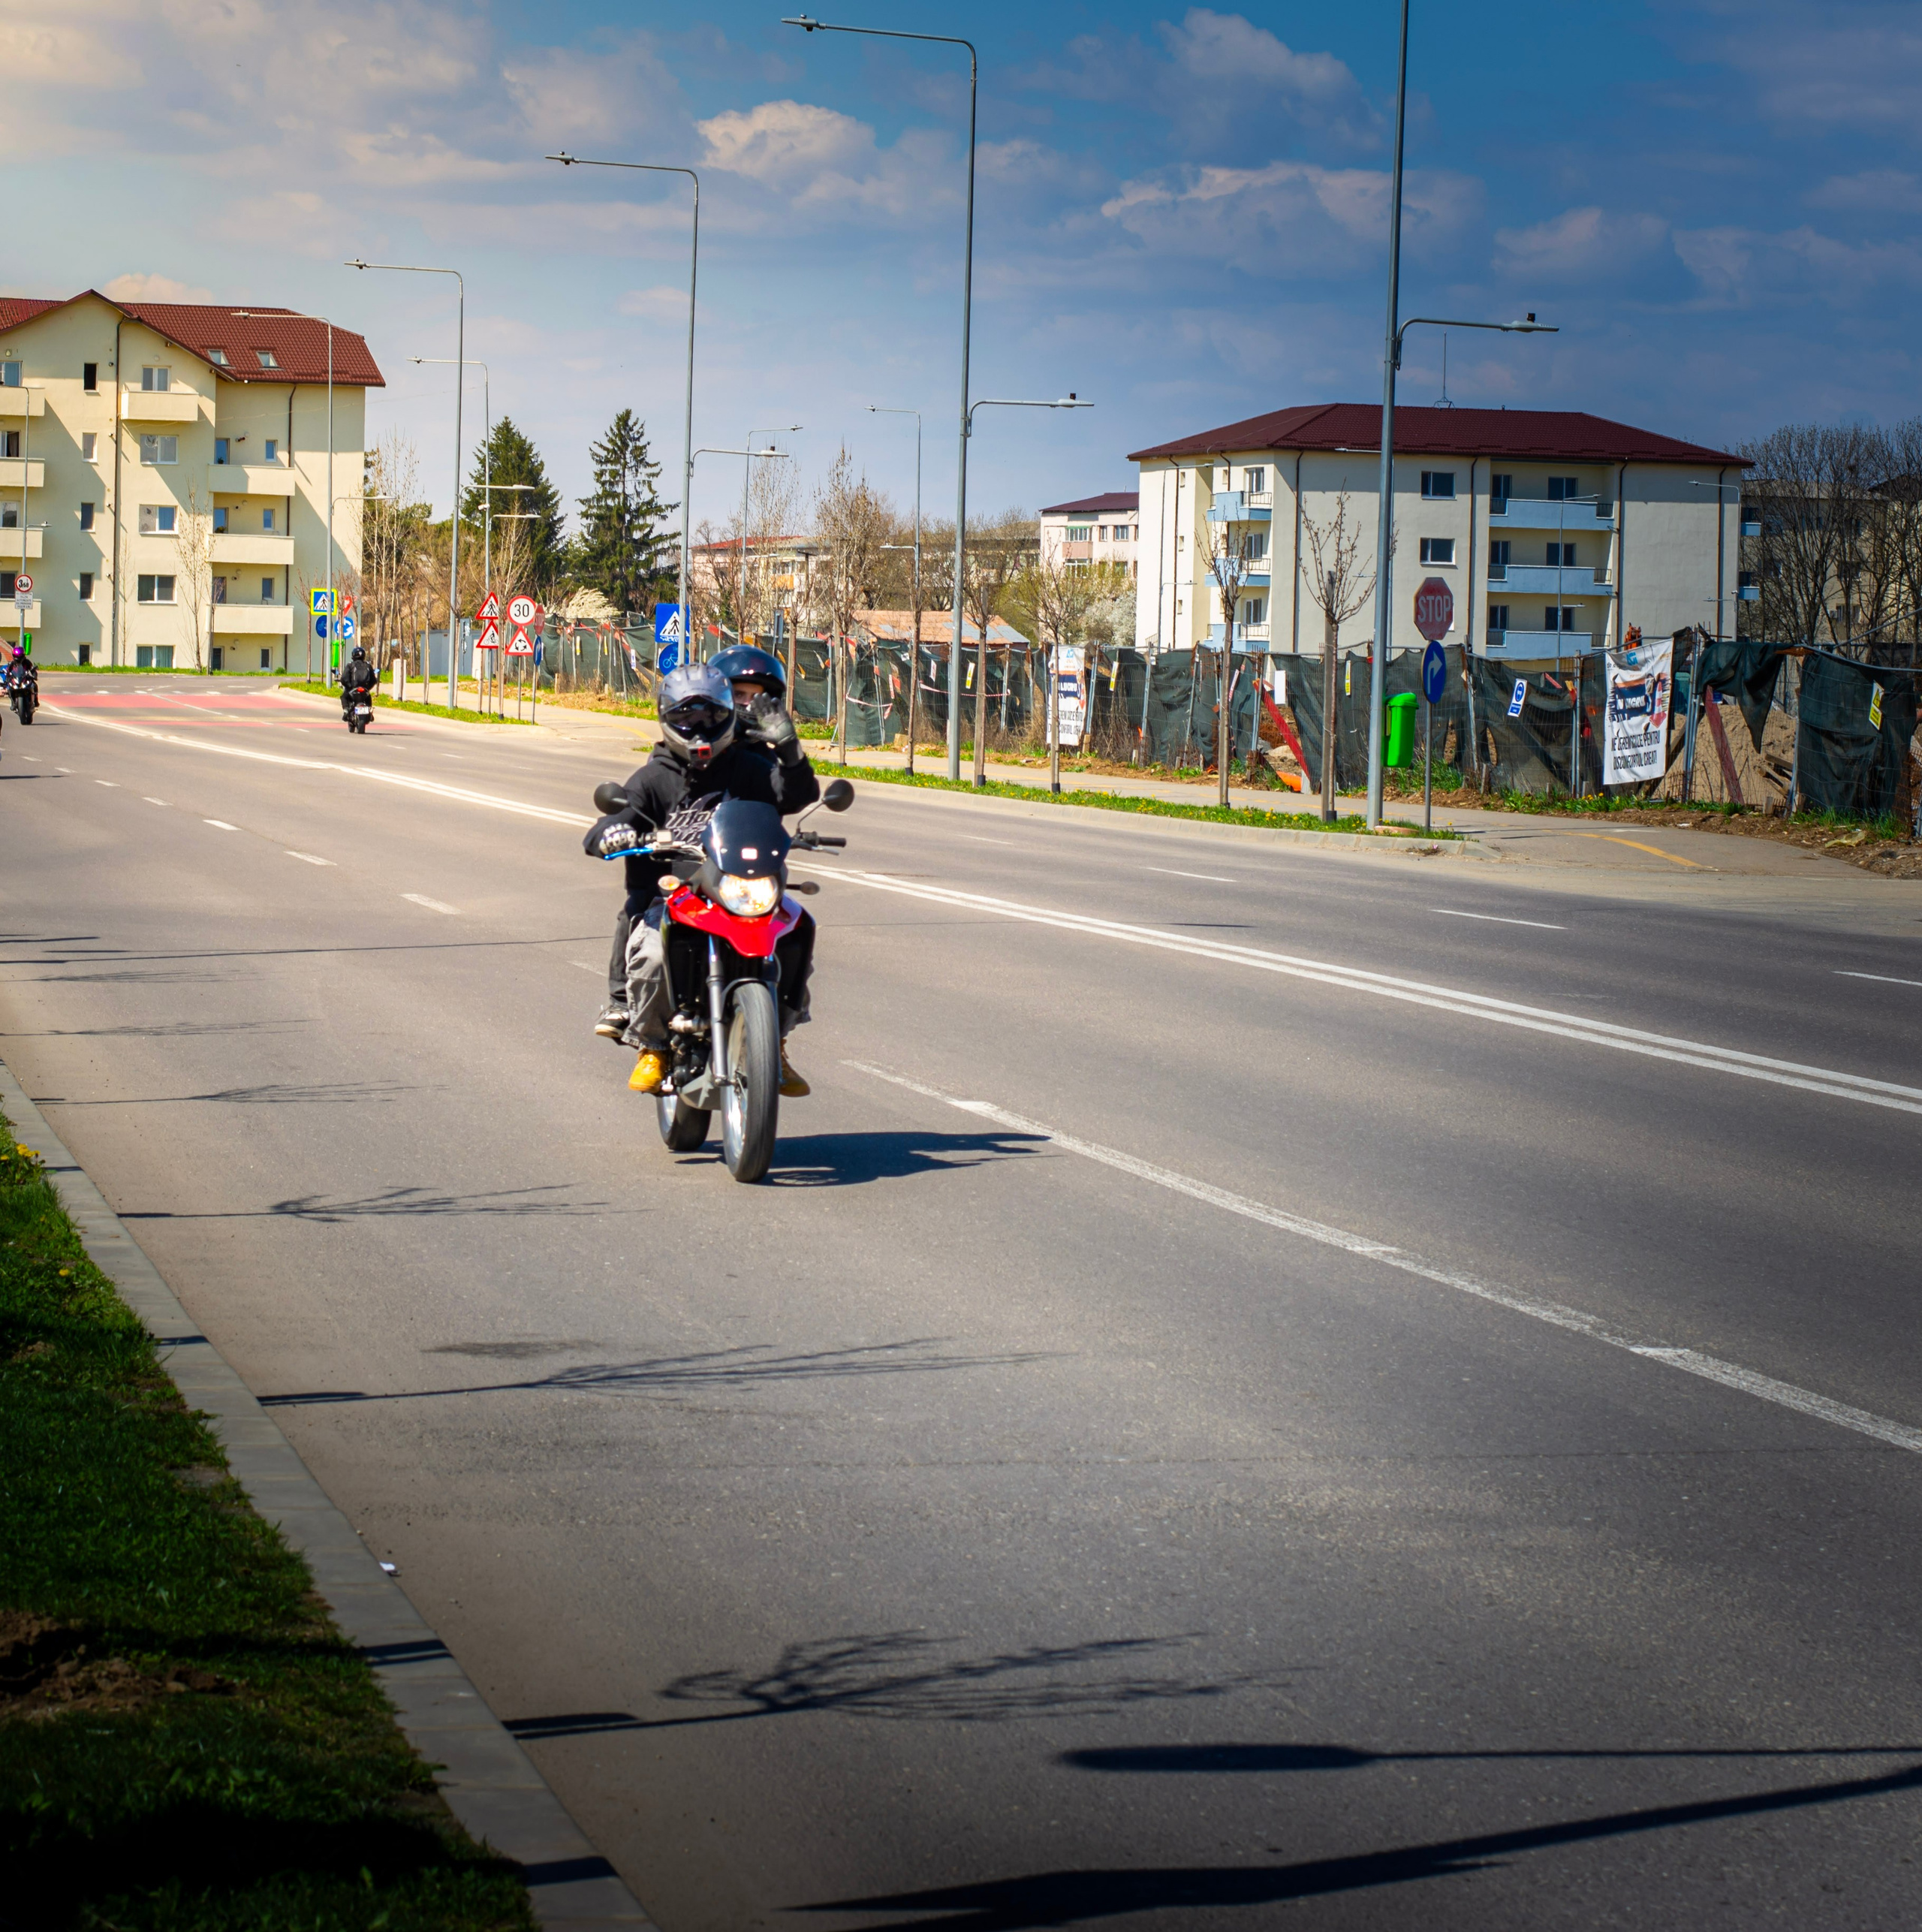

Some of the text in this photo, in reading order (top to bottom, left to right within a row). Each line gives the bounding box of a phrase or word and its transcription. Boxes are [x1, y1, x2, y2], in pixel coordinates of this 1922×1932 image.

[514, 604, 529, 617] 30
[1417, 595, 1451, 622] STOP
[1643, 730, 1660, 746] PENTRU
